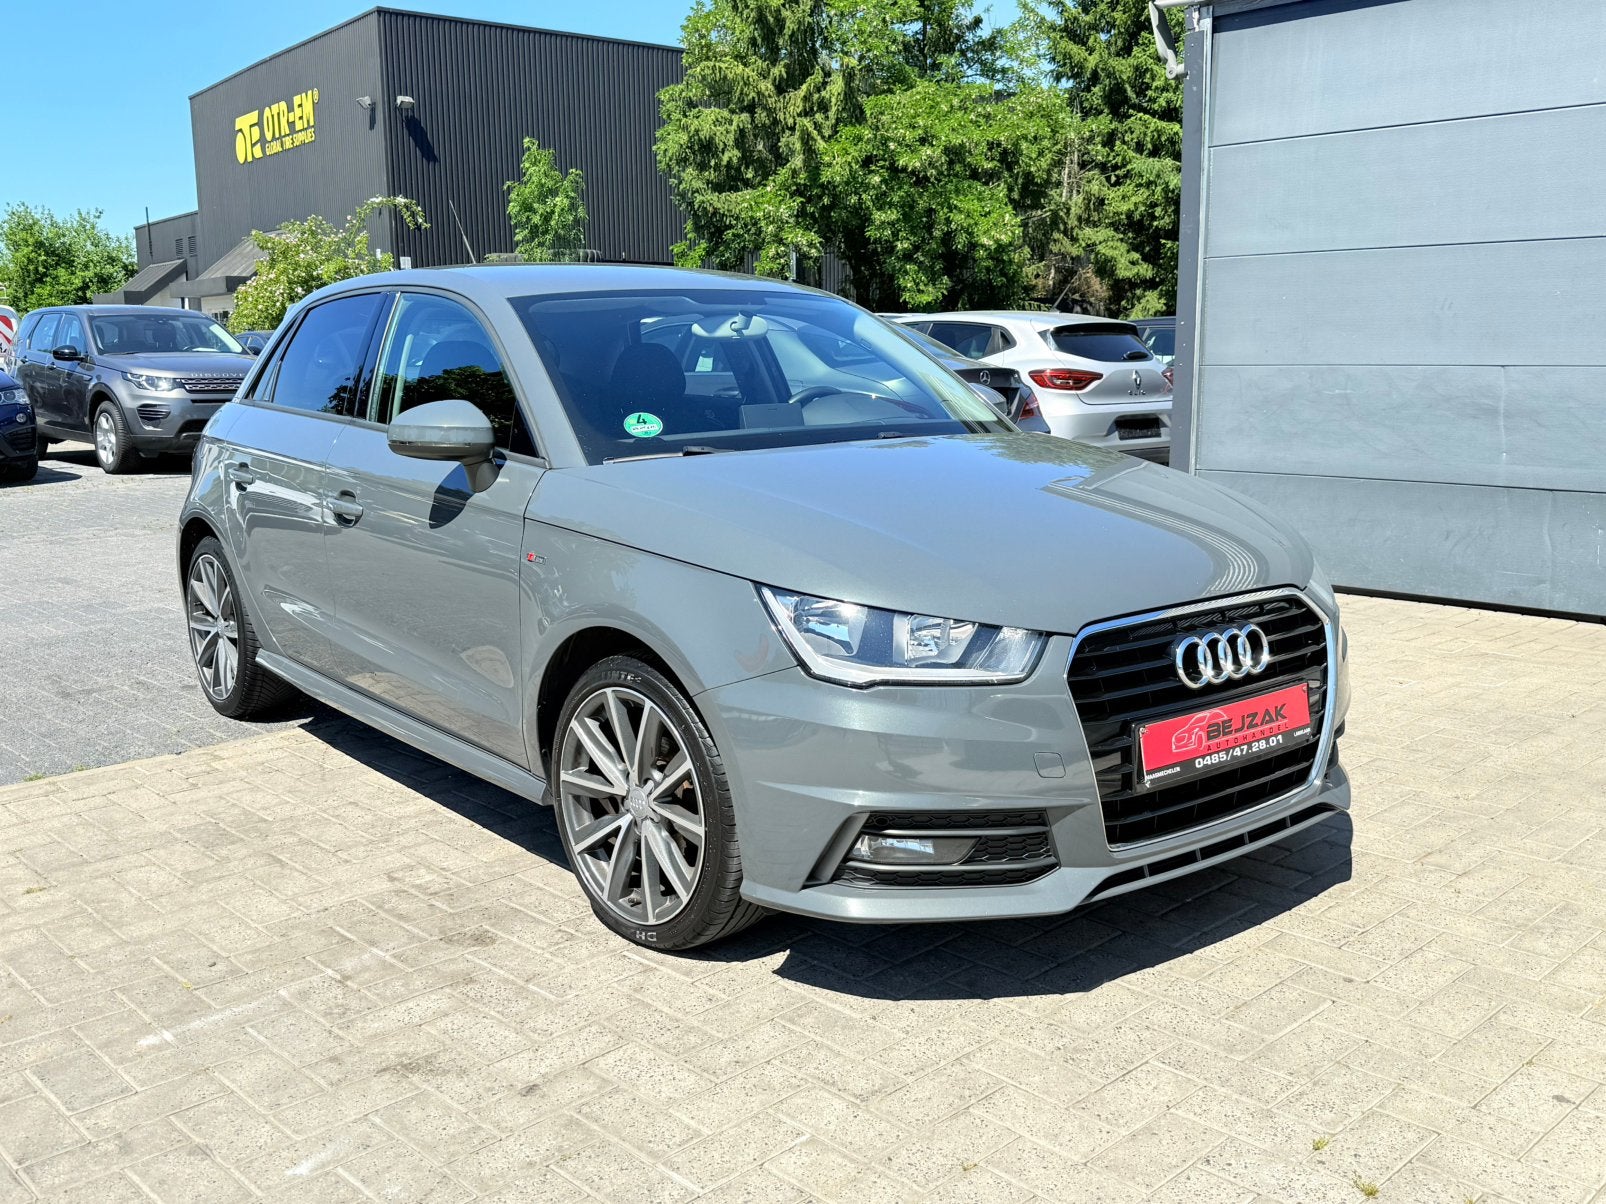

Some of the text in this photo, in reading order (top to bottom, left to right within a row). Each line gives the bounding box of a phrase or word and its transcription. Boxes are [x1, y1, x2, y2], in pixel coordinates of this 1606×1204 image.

[637, 414, 648, 425] 4
[1206, 703, 1287, 740] BEJZAK
[1195, 734, 1283, 768] 0485/47.28.01
[1207, 723, 1289, 752] AUTOHANDEL
